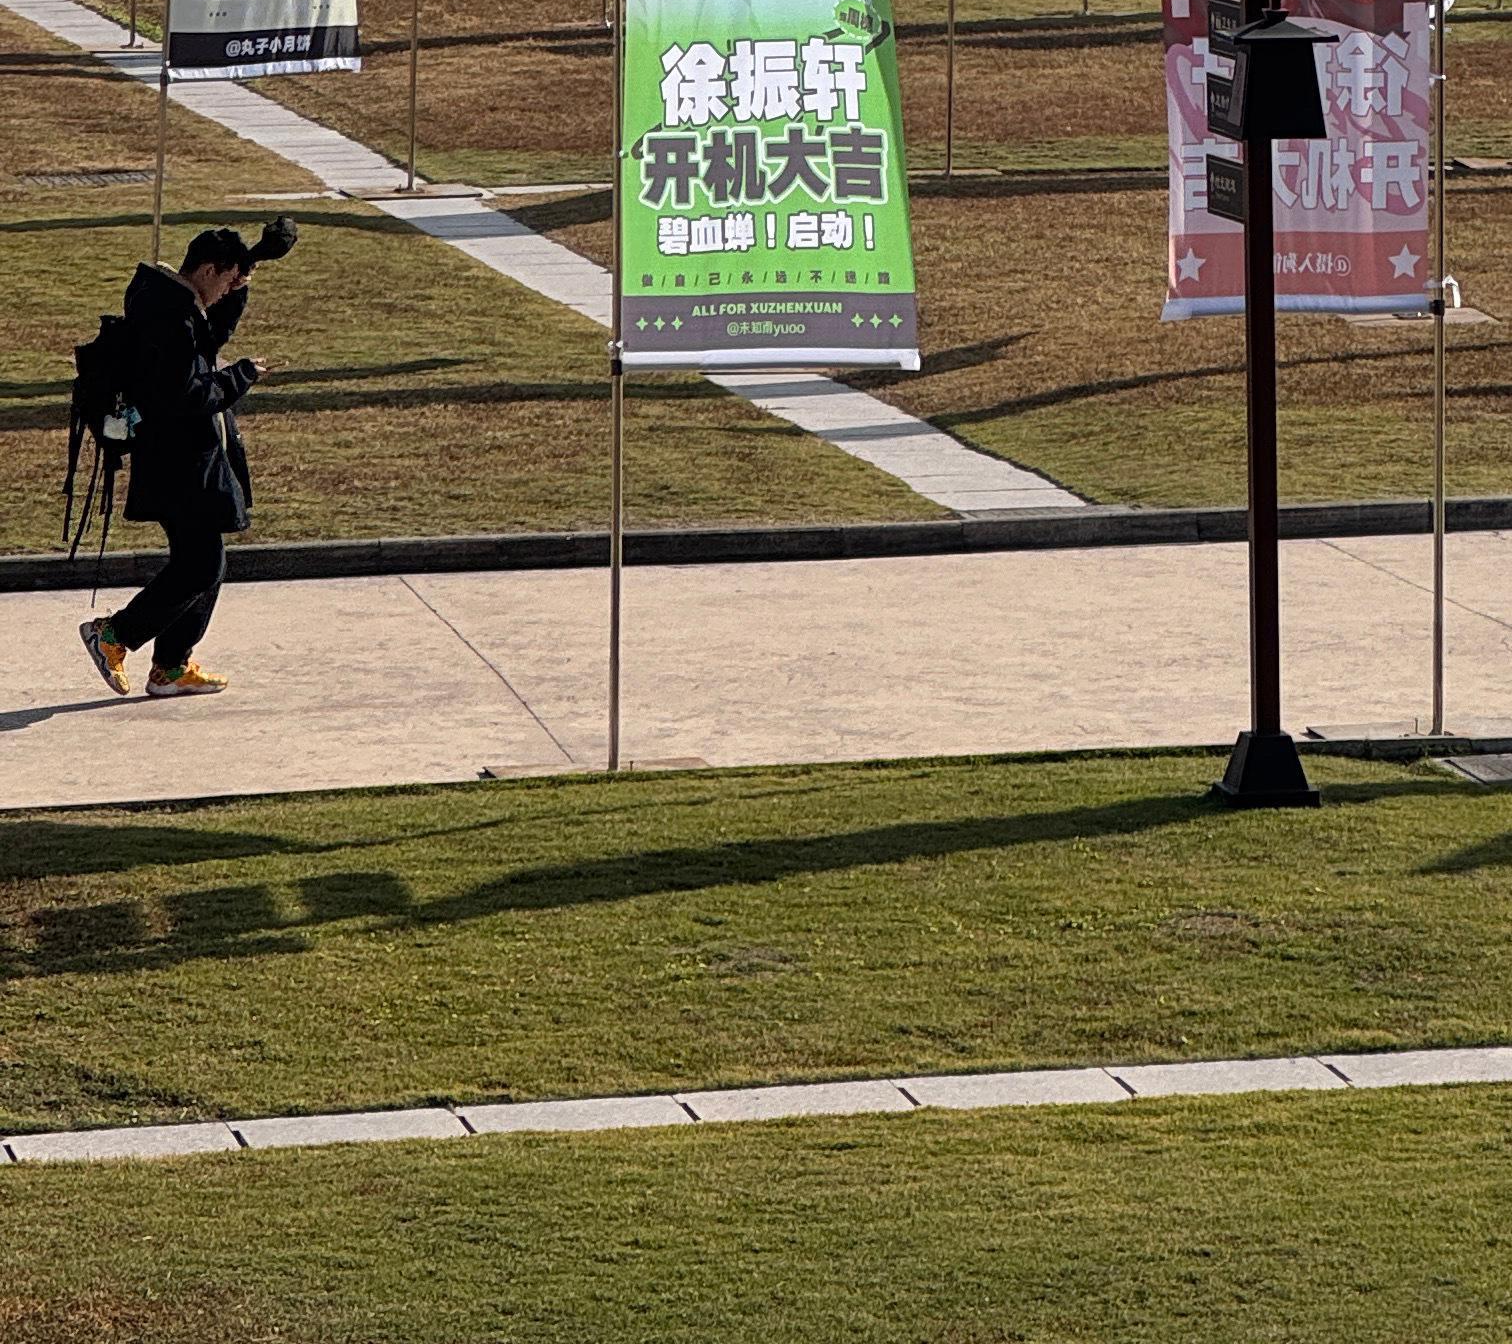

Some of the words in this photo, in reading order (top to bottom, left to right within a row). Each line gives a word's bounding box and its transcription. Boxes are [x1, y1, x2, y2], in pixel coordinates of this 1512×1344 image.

[659, 35, 868, 128] 徐振轩
[639, 123, 889, 209] 开机大吉
[691, 305, 717, 317] ALL
[719, 303, 747, 316] FOR
[750, 302, 843, 315] XUZHENXUAN
